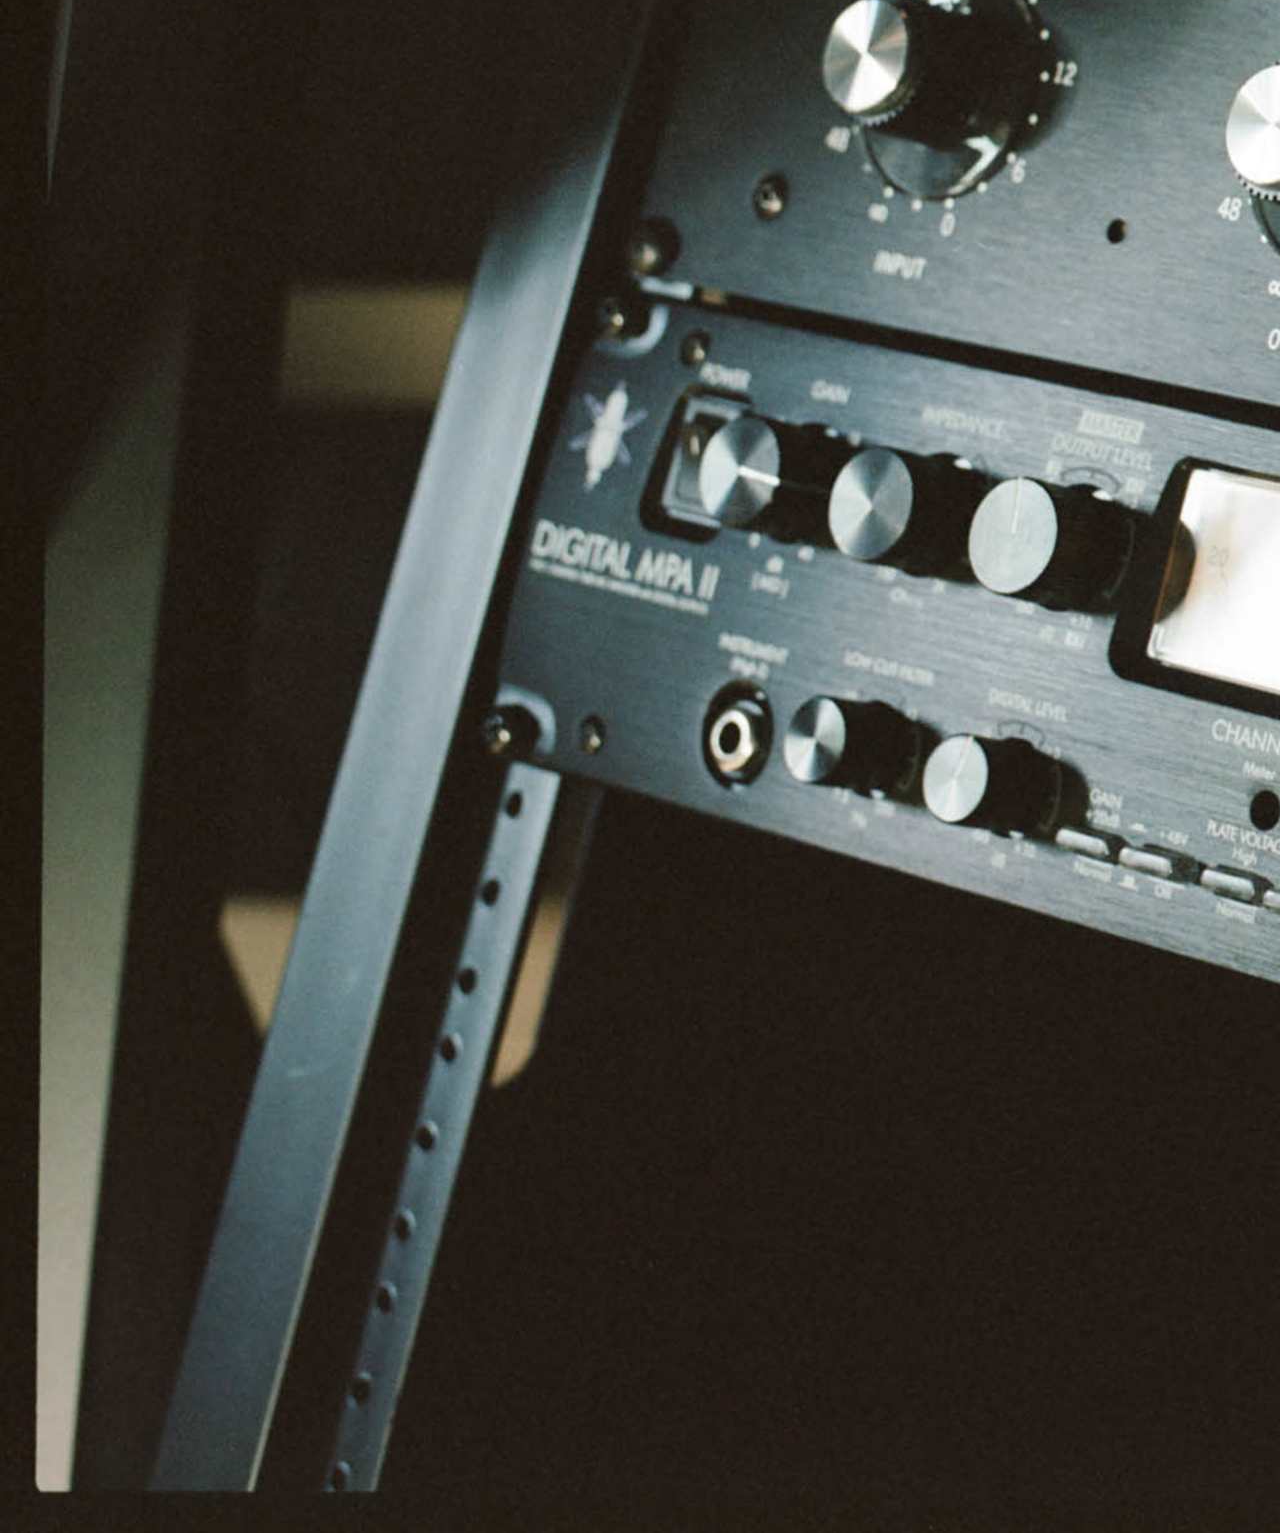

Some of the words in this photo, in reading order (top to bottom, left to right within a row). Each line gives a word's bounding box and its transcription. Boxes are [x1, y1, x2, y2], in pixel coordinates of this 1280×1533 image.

[1053, 60, 1078, 87] 12
[1217, 198, 1242, 221] 48
[531, 519, 632, 581] DIGITAL
[635, 546, 694, 597] MPA
[1206, 819, 1241, 845] PLATE
